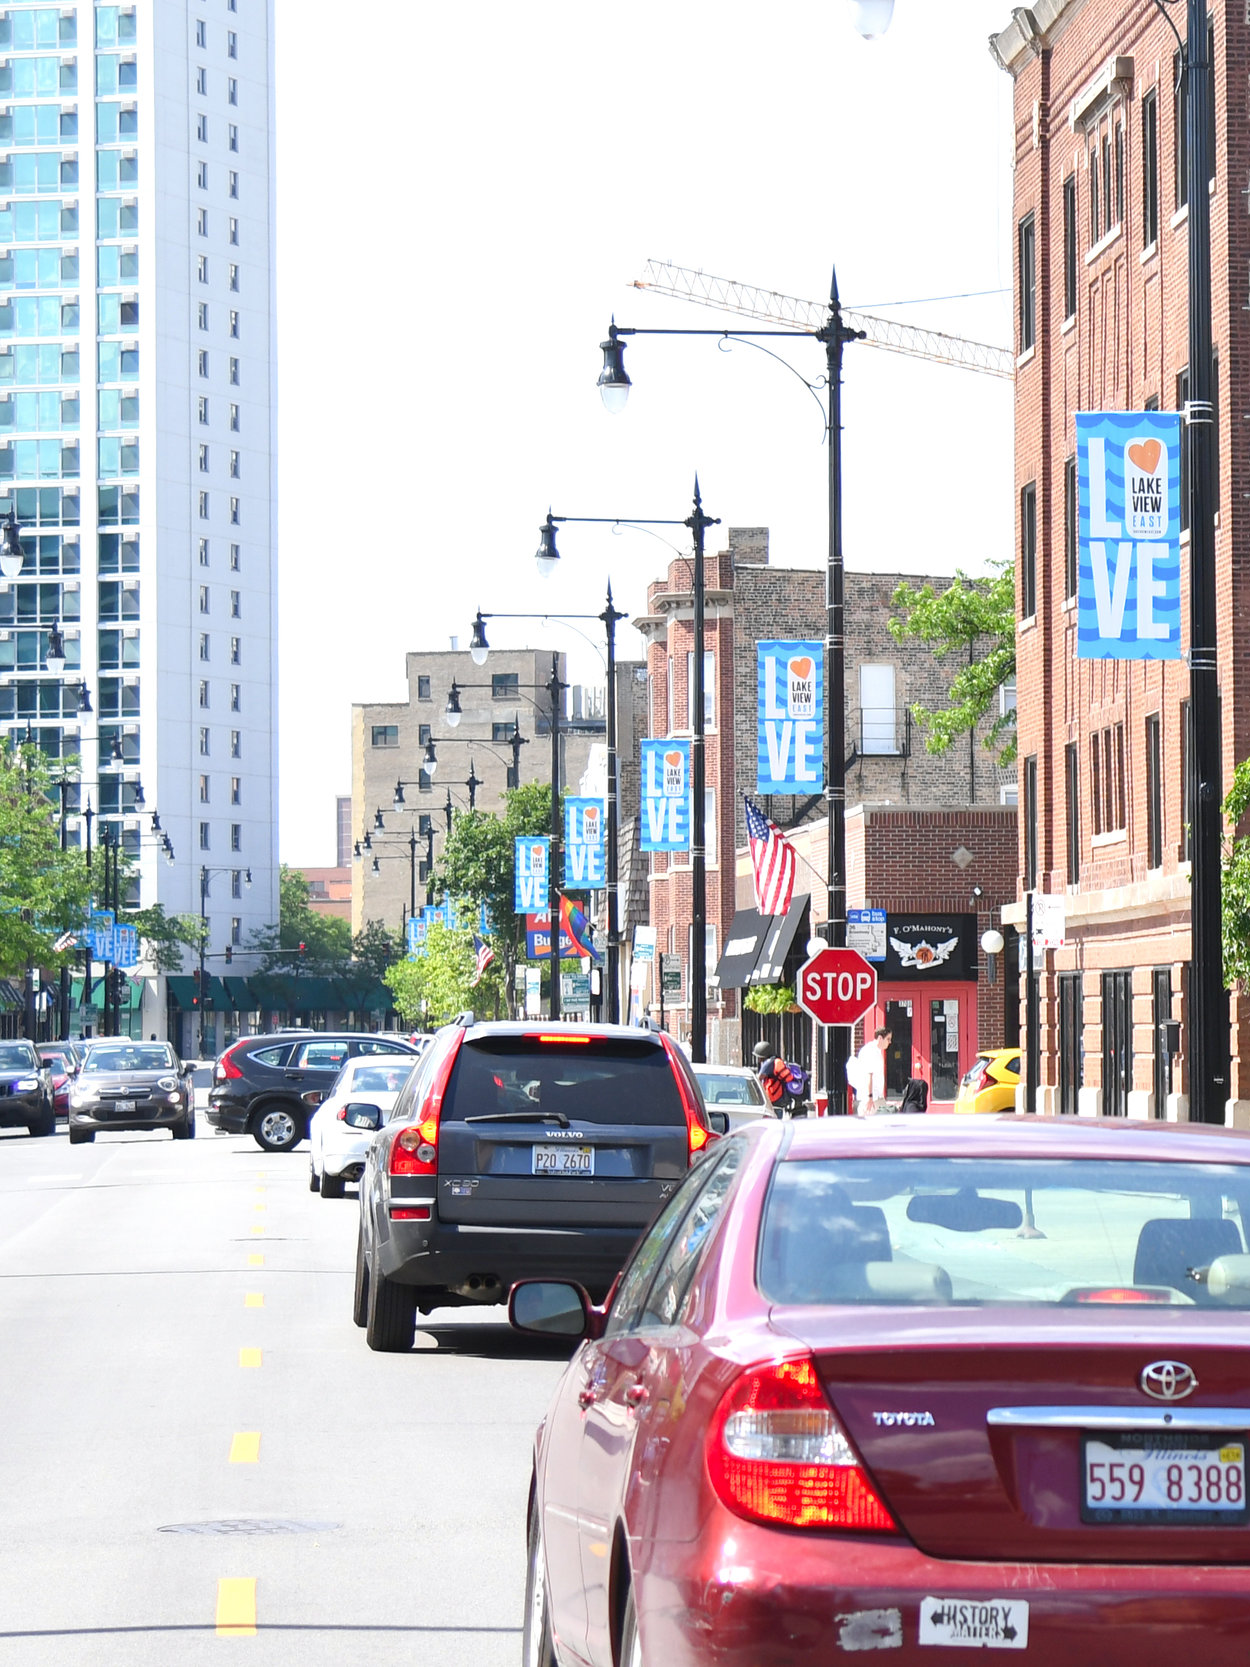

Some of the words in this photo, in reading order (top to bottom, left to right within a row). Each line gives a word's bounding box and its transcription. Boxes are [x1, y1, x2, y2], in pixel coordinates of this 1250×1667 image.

[1132, 477, 1162, 494] LAKE
[1132, 496, 1162, 513] VIEW
[1132, 515, 1162, 528] EAST
[1089, 541, 1170, 639] VE
[792, 681, 812, 692] LAKE
[792, 693, 812, 703] VIEW
[765, 721, 816, 781] VE
[666, 769, 681, 777] LAKE
[666, 777, 681, 785] VIEW
[646, 798, 684, 842] VE
[806, 972, 872, 1001] STOP
[545, 1131, 584, 1139] VOLVO
[563, 1154, 590, 1169] 2670
[872, 1411, 936, 1426] TOYOTA
[1089, 1462, 1145, 1502] 559
[1166, 1464, 1242, 1503] 8388
[941, 1604, 1012, 1630] HISTORY
